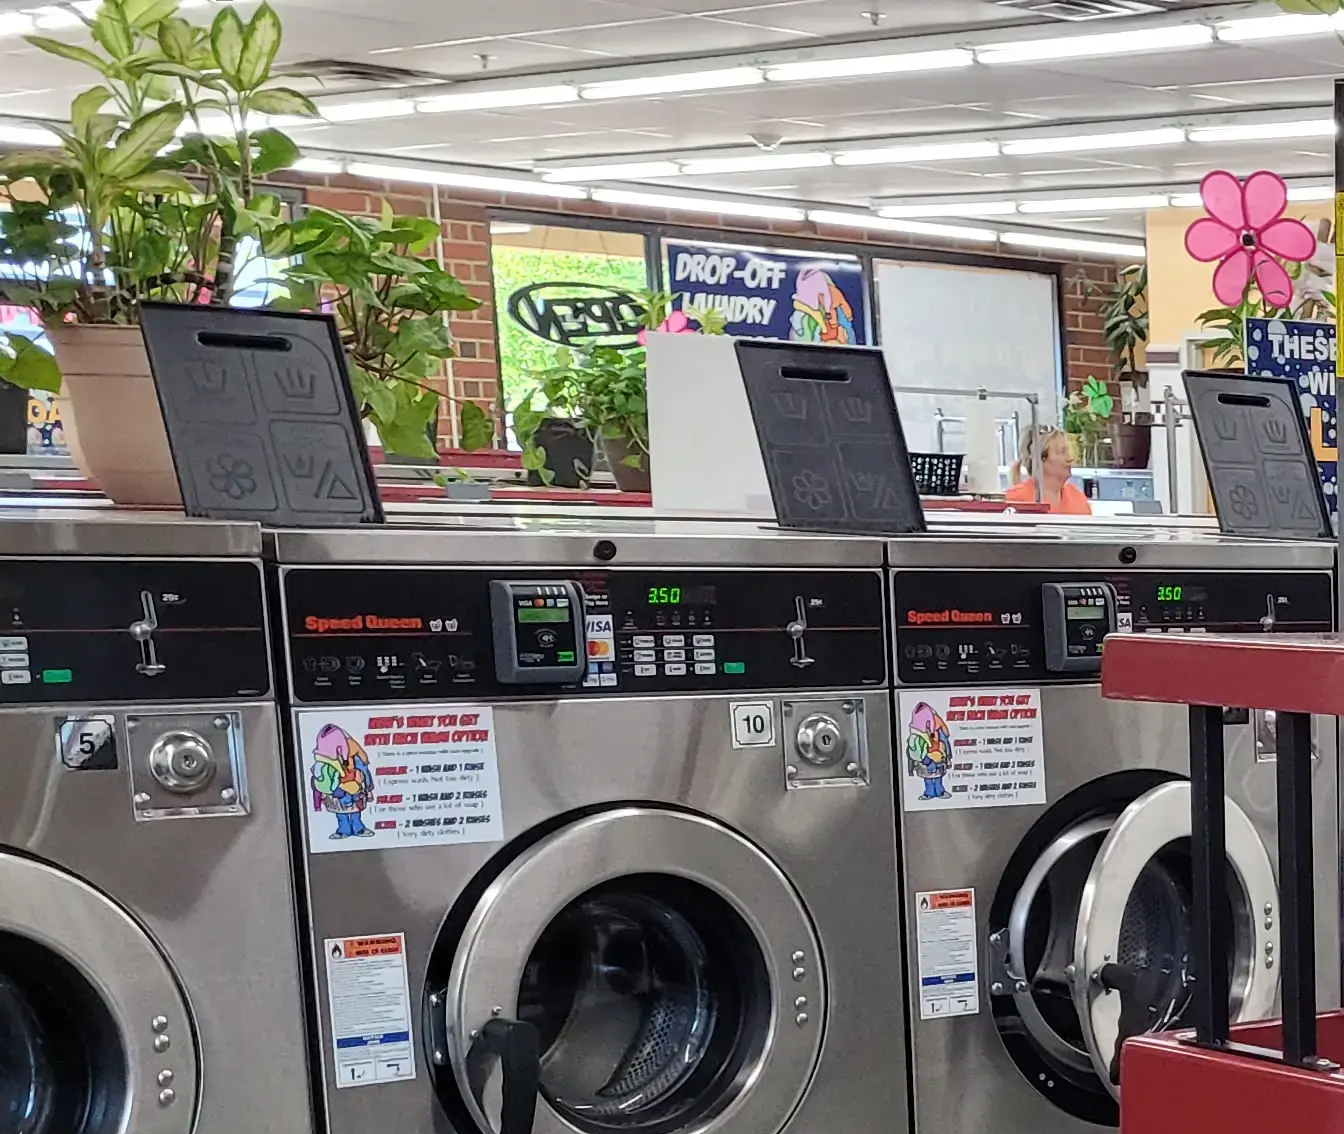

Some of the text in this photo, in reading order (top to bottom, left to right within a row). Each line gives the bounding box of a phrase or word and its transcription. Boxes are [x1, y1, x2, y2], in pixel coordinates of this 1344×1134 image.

[675, 252, 787, 289] DROP-OFF
[305, 615, 422, 632] Speed Queen
[908, 610, 992, 624] Speed Queen
[742, 715, 764, 733] 10
[79, 733, 95, 754] 5
